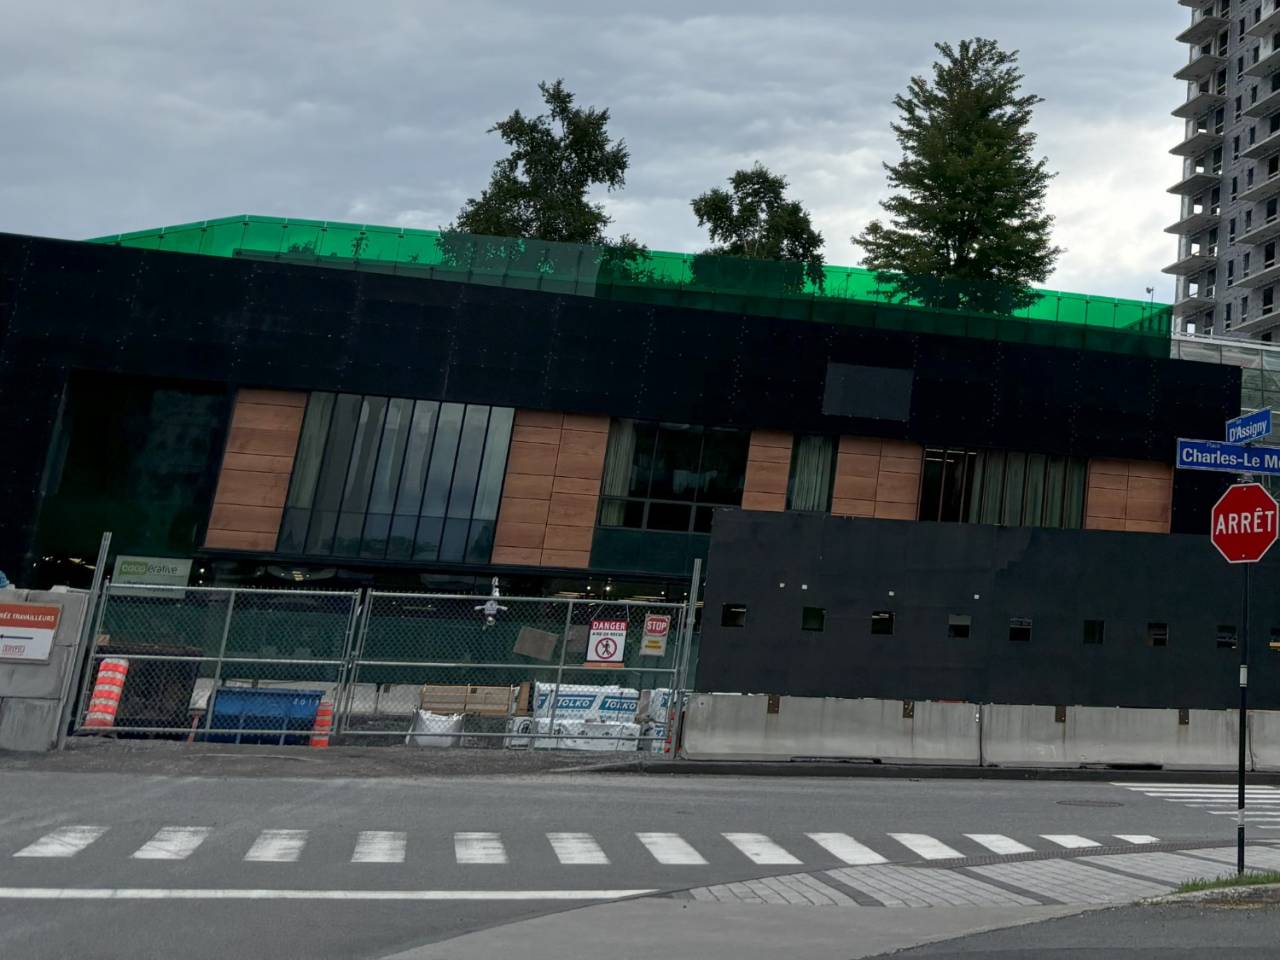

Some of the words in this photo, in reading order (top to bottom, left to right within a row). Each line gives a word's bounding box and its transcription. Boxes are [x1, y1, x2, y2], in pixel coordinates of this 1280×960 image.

[1229, 420, 1268, 442] D'Assigny
[1182, 448, 1260, 467] Charles-Le
[1215, 507, 1275, 534] ARRÊT
[592, 622, 626, 630] DANGER
[647, 621, 667, 631] STOP
[557, 697, 592, 707] TOLKO
[605, 698, 637, 710] TOLKO
